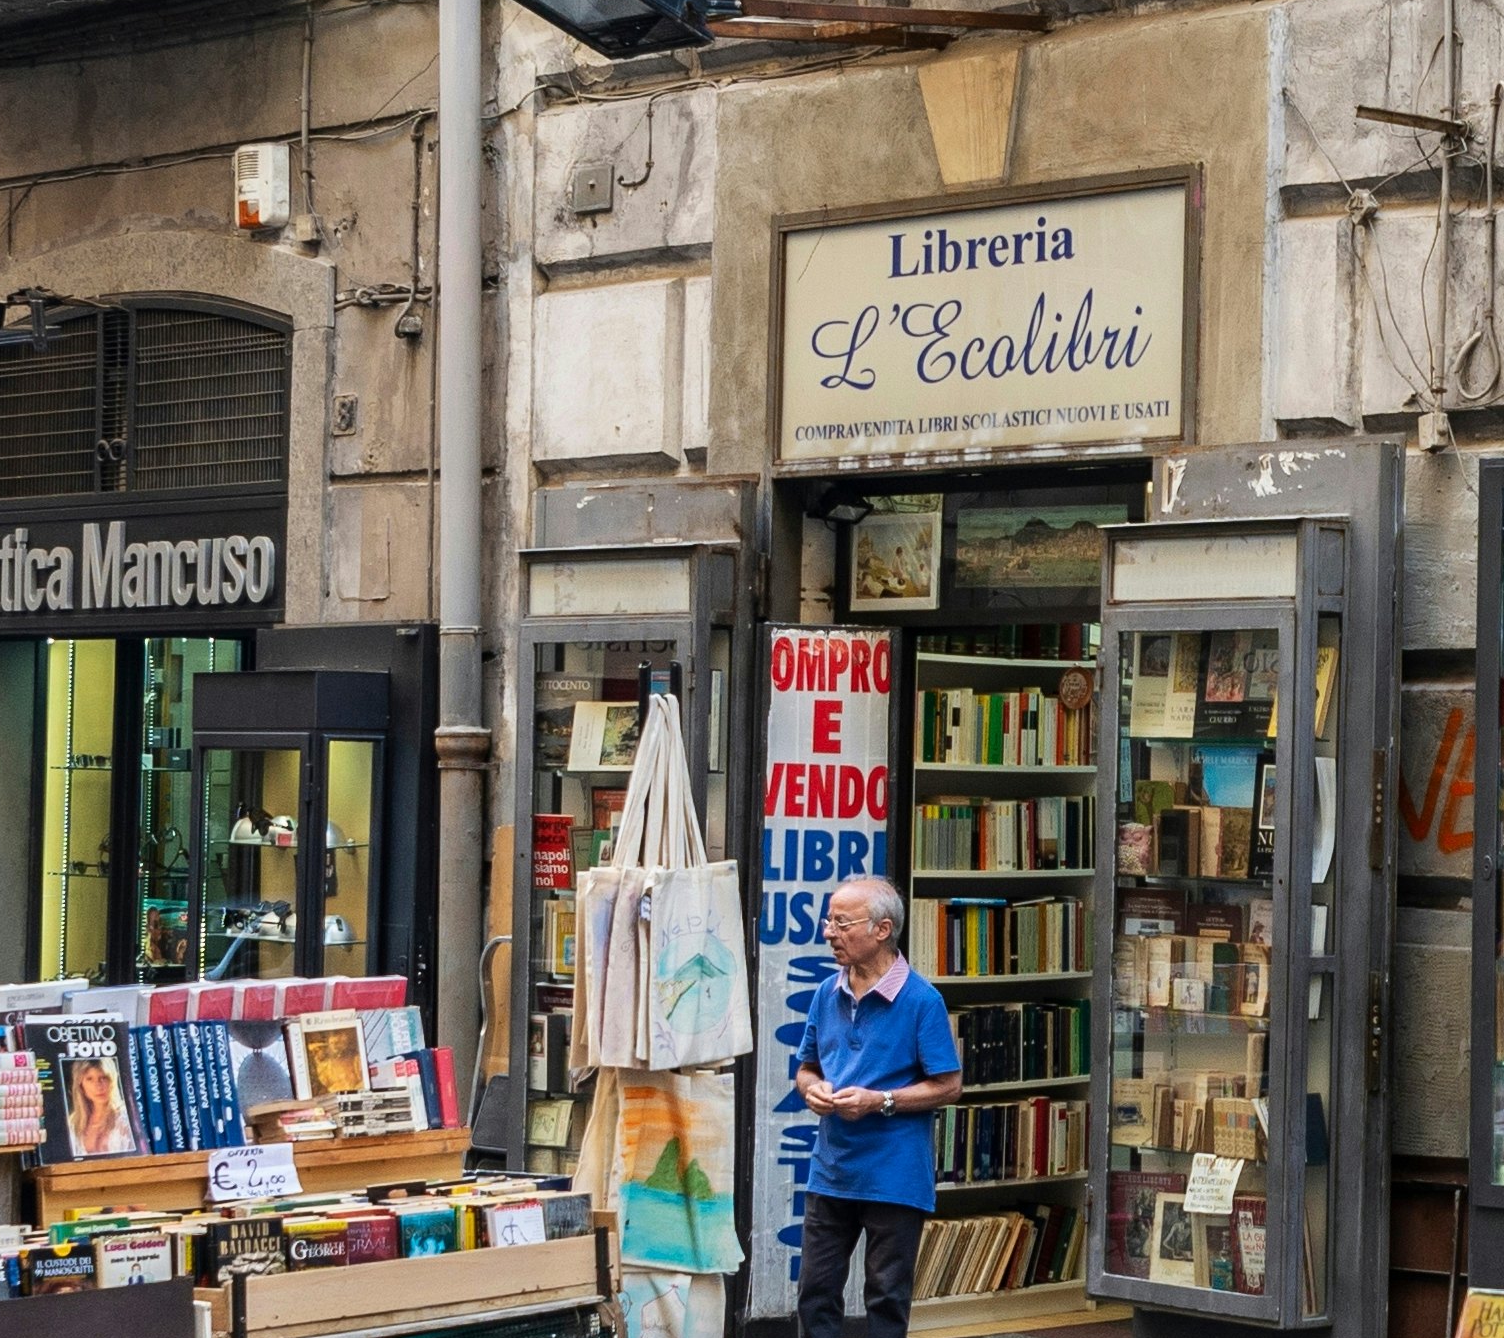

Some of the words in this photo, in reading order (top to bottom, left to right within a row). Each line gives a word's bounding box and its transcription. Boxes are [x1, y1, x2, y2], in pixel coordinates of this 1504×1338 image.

[887, 216, 1075, 279] Libreria
[811, 287, 1153, 391] L'Ecolibri
[795, 419, 915, 443] COMPRAVENDITA
[918, 414, 959, 435] LIBRI
[961, 407, 1052, 432] SCOLASTICI
[1054, 404, 1106, 425] NUOVI
[1109, 403, 1120, 421] E
[1124, 399, 1170, 421] USATI
[81, 520, 276, 609] Mancuso
[771, 636, 892, 695] OMPRO
[536, 679, 591, 691] OTTOCENTO
[811, 699, 843, 755] E
[762, 763, 889, 821] VENDO
[533, 848, 571, 862] napoli
[534, 862, 569, 874] siamo
[762, 826, 889, 882] LIBRI
[535, 873, 555, 887] noi
[69, 1041, 117, 1057] FOTO
[145, 1030, 156, 1066] BOTTA
[160, 1027, 174, 1070] FUKSAS
[179, 1027, 192, 1071] WRIGHT
[214, 1024, 229, 1066] ISOZAKI
[149, 1066, 161, 1103] MARIO
[183, 1071, 196, 1105] LLOYD
[198, 1072, 210, 1108] RAFAEL
[220, 1065, 233, 1102] ARATA
[166, 1070, 185, 1149] MASSIMILIANO
[228, 1147, 264, 1158] OFFERTA
[104, 1241, 127, 1253] Luca
[128, 1239, 167, 1253] Goldoni
[219, 1236, 282, 1255] BALDACCI
[230, 1222, 271, 1240] DAVID
[44, 1256, 78, 1268] CUSTODE
[78, 1256, 92, 1266] DEI
[111, 1256, 125, 1264] non
[126, 1255, 136, 1263] ho
[137, 1252, 160, 1264] parole
[290, 1240, 347, 1260] GEORGE
[45, 1264, 94, 1278] MANOSCRITTI
